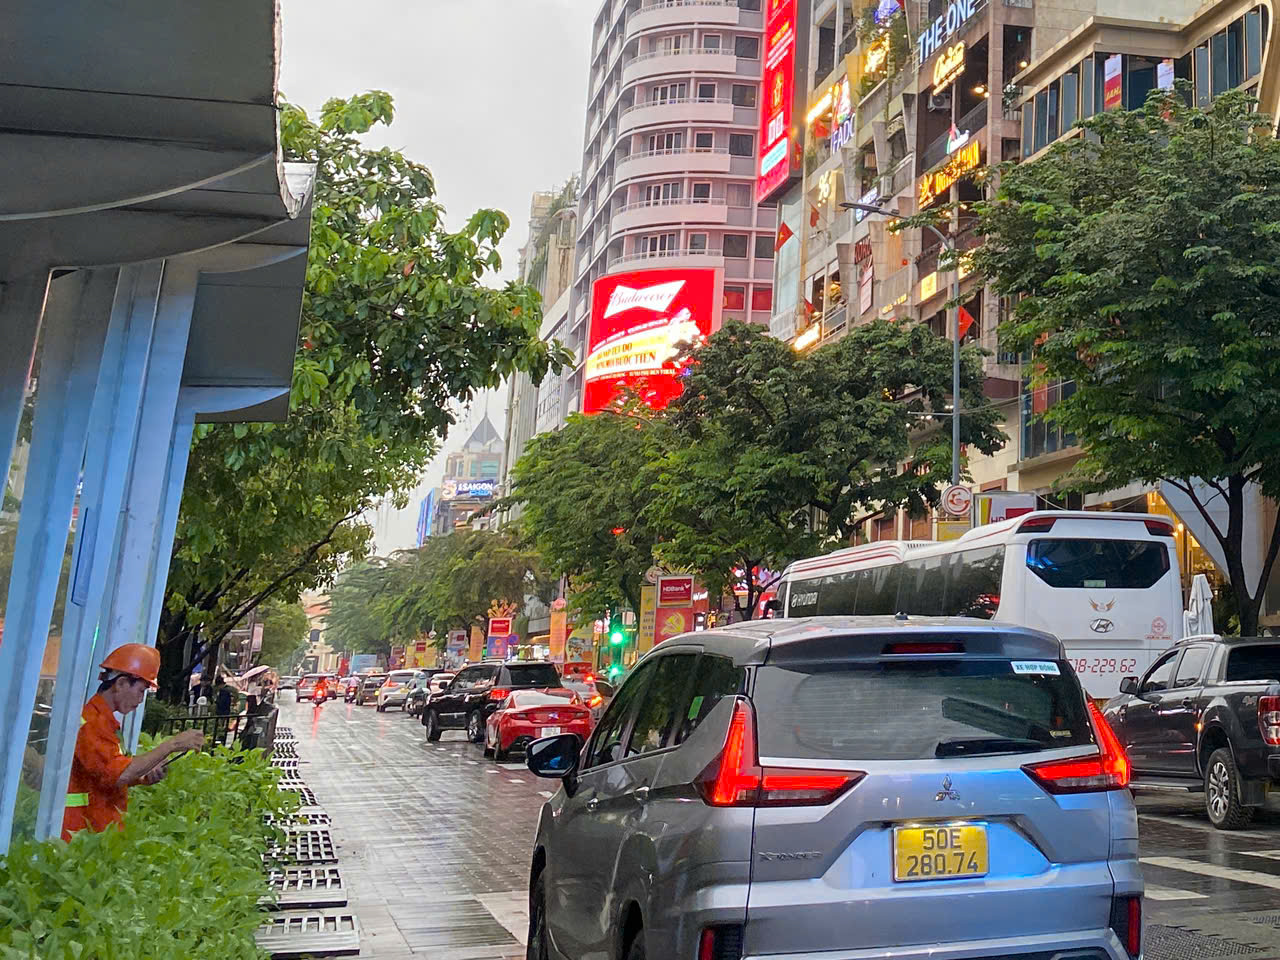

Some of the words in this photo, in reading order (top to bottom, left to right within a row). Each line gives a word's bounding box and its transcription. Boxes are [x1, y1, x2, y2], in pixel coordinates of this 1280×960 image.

[918, 15, 943, 64] THE
[923, 828, 961, 851] 50E
[907, 852, 978, 876] 280.74
